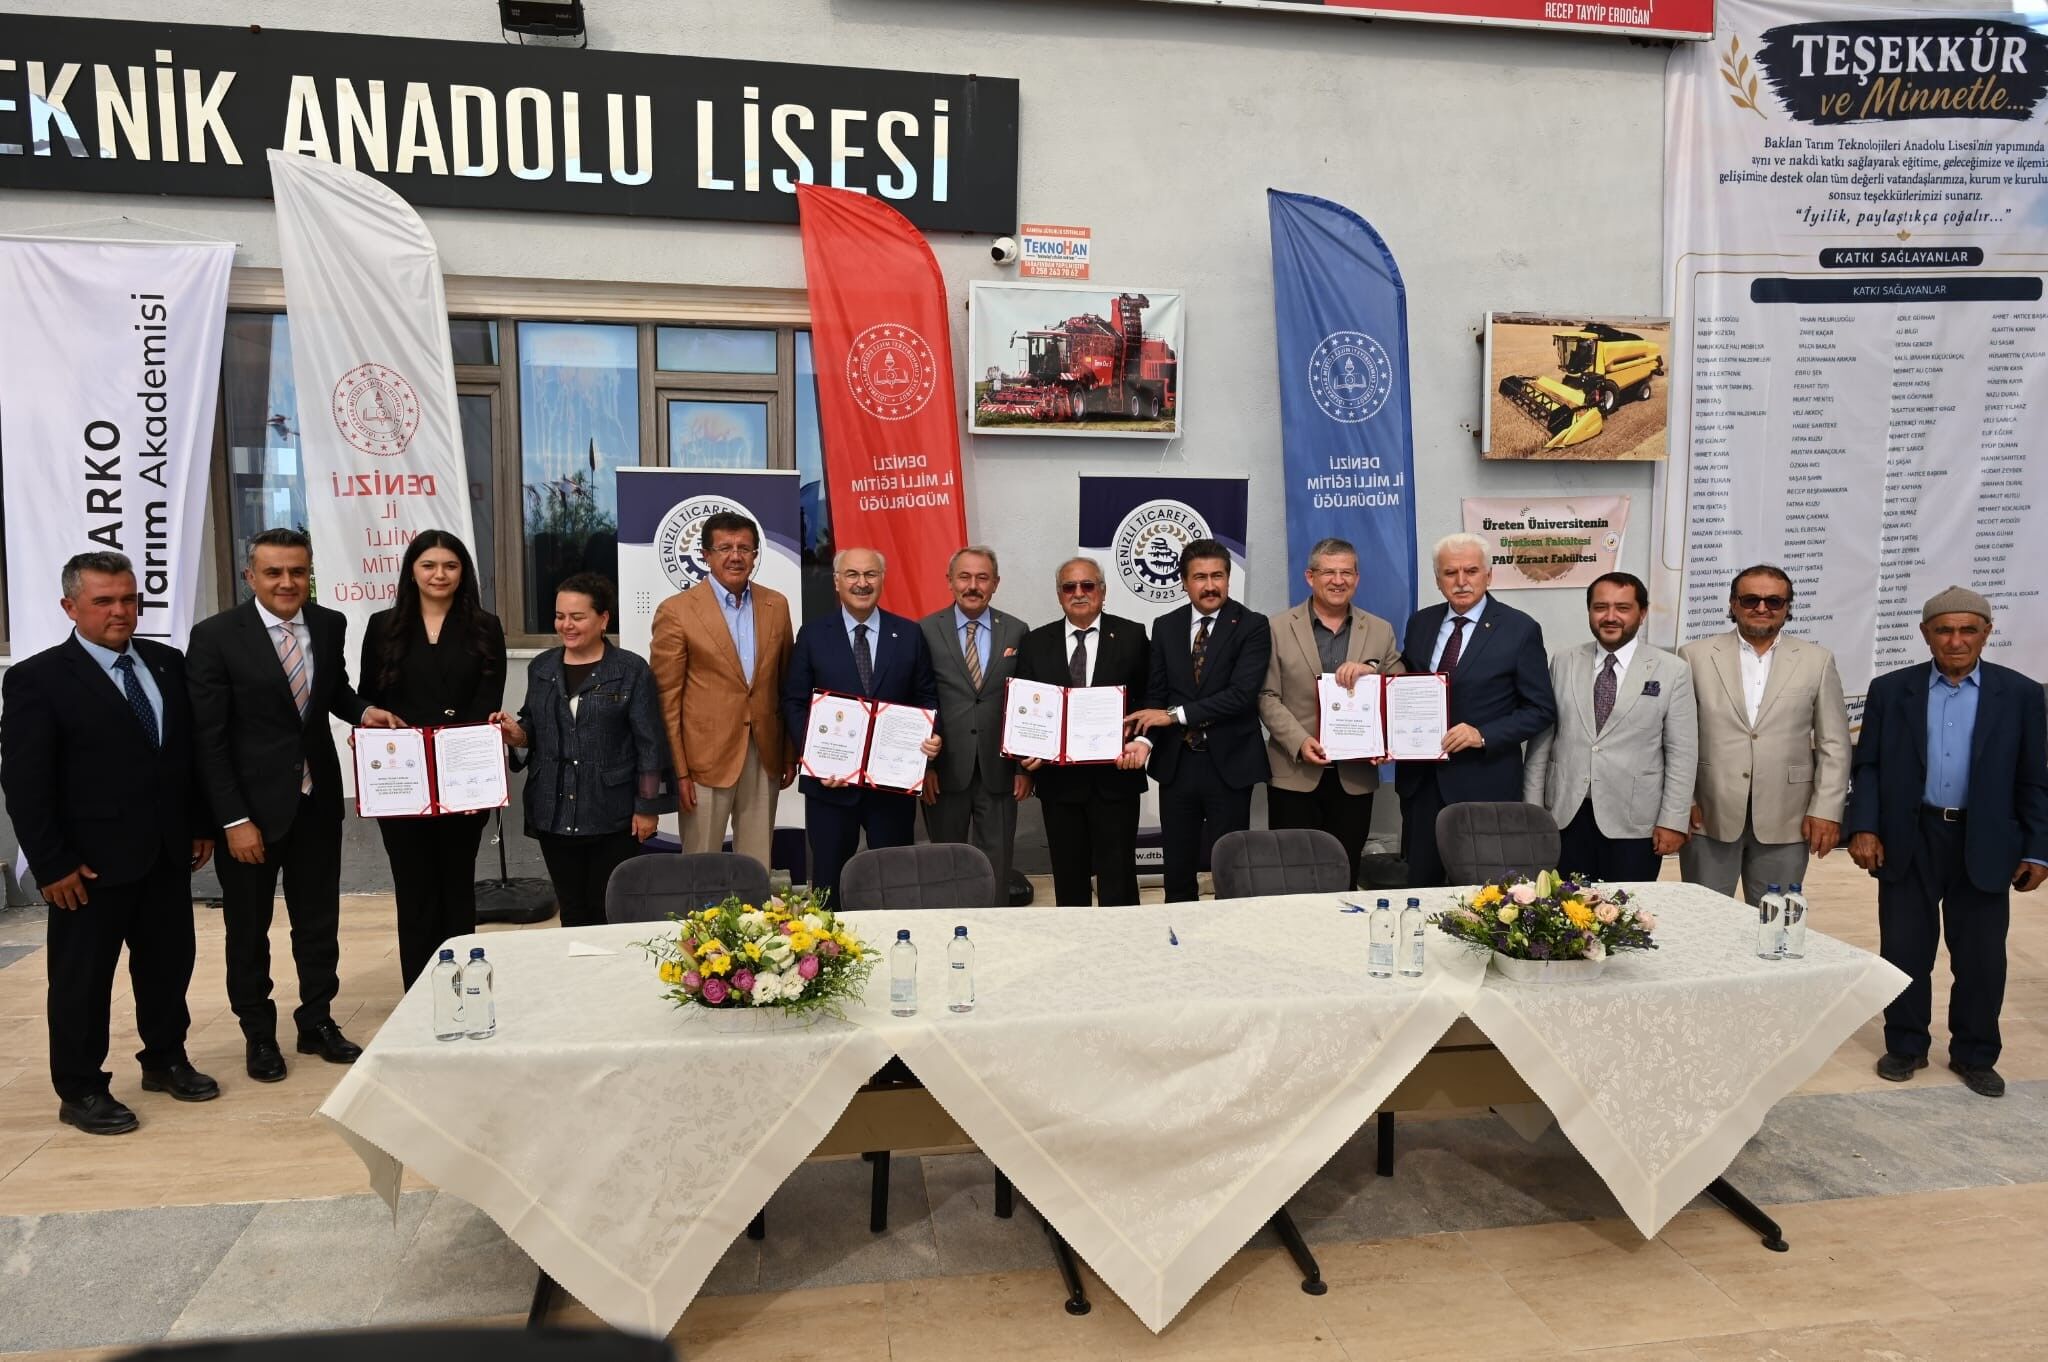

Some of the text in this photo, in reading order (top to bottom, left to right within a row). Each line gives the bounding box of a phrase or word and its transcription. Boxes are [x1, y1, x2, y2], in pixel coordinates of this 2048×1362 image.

[1545, 1, 1650, 25] RECEP TAYYİP ERDOĞAN
[1792, 26, 2028, 86] TEŞEKKÜR
[1820, 90, 1854, 117] ve
[282, 74, 654, 186] ANADOLU
[697, 86, 949, 202] LİSESİ
[1764, 136, 1802, 148] Baklan
[1804, 137, 1834, 150] Tarım
[1837, 138, 1901, 153] Teknolojileri
[1903, 139, 1945, 151] Anadolu
[1995, 140, 2045, 154] yapımında
[1751, 155, 1771, 168] aynı
[1774, 156, 1786, 166] ve
[1788, 154, 1819, 166] nakdi
[1820, 155, 1845, 167] katkı
[1847, 155, 1900, 170] sağlayarak
[1902, 156, 1941, 171] eğitime,
[1942, 155, 2002, 171] geleceğimize
[2004, 158, 2015, 168] ve
[1719, 170, 2048, 187] gelişimine destek olan tüm değerli vatandaşlarımıza, kurum ve kurulu
[1828, 188, 1983, 204] sonsuz teşekkürlerimizi sunarız.
[1856, 208, 1938, 227] paylaştıkça
[1835, 250, 1968, 264] KATKI SAĞLAYANLAR
[1853, 283, 1947, 296] KATKI SAĞLAYANLAR
[130, 293, 169, 617] Tarım Akademisi
[1483, 516, 1609, 531] Üreten Üniversitenin
[663, 504, 737, 573] DENİZLİ TİCARE
[1120, 509, 1188, 577] DENİZLİ TİCARET
[1545, 535, 1592, 547] Fakültesi
[1492, 552, 1597, 565] PAU Ziraat Fakültesi
[1149, 589, 1176, 599] 1923
